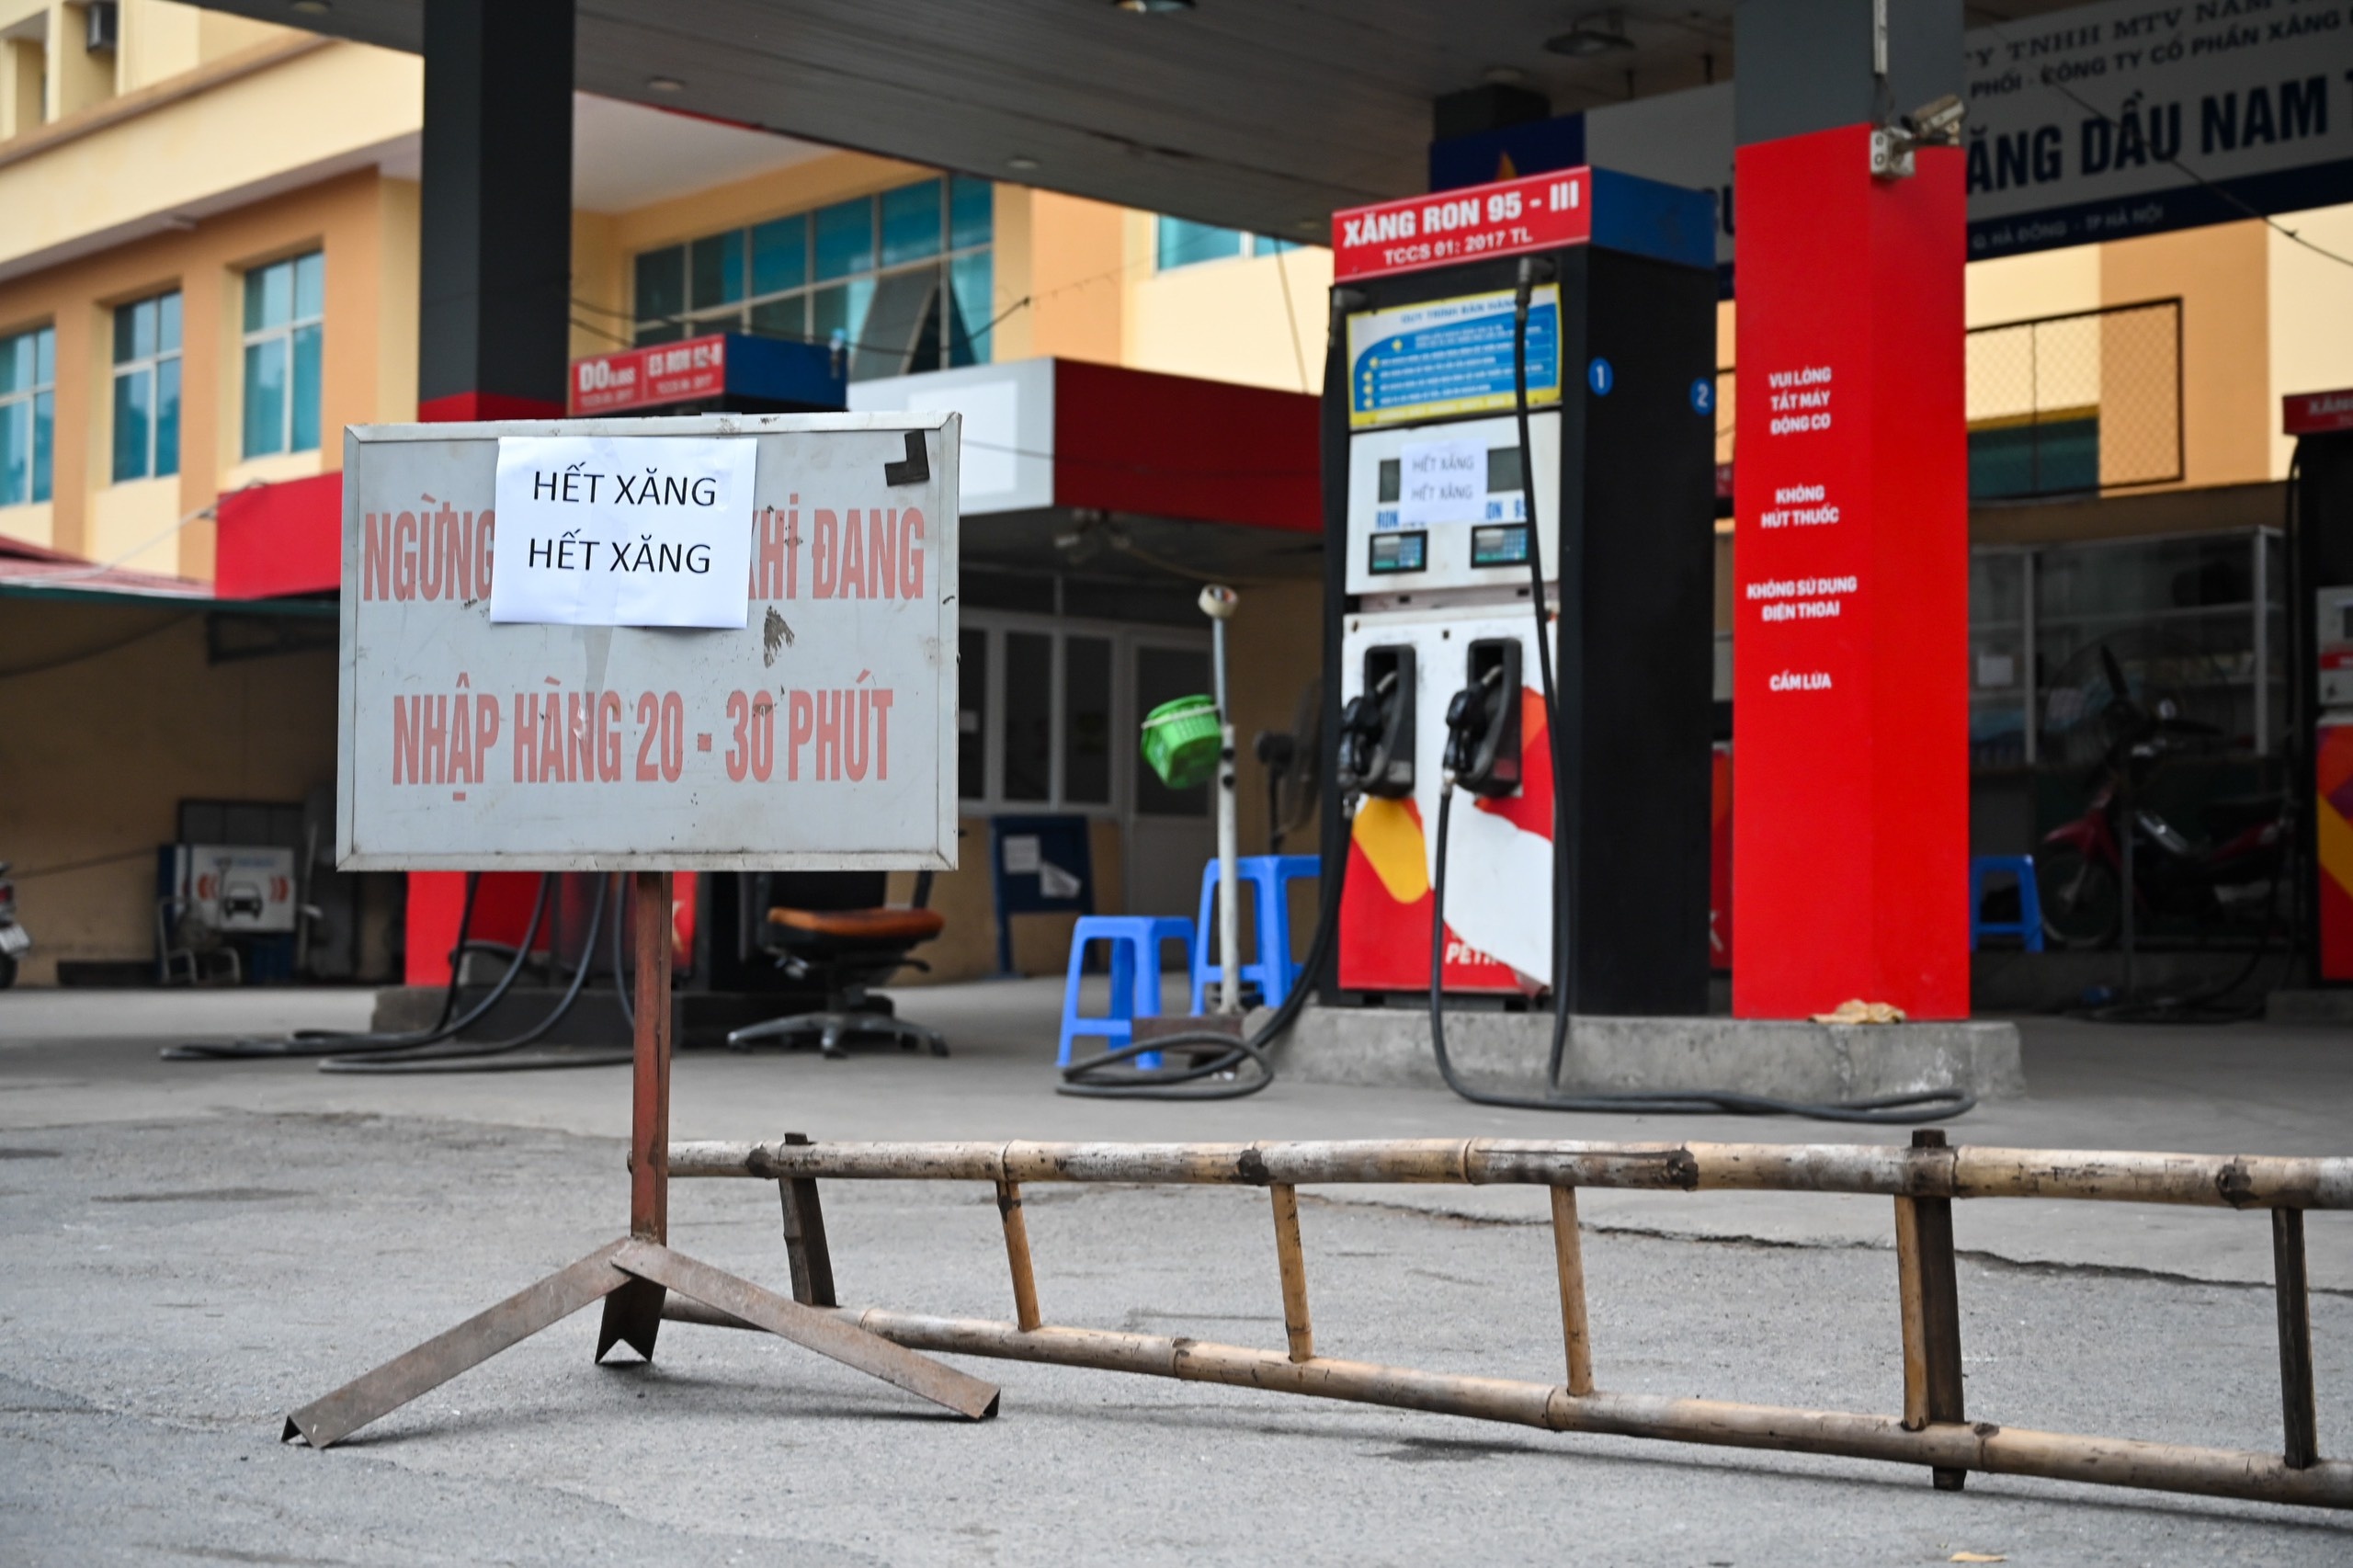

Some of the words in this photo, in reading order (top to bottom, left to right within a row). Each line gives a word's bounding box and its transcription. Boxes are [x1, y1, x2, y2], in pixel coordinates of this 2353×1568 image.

[2006, 24, 2099, 61] TNHH
[2113, 6, 2184, 40] MTV
[2114, 50, 2144, 72] TY
[1967, 125, 2063, 195] ĂNG
[2080, 90, 2180, 176] DẦU
[2200, 74, 2328, 155] NAM
[1343, 210, 1416, 248] XĂNG
[1423, 199, 1480, 233] RON
[1487, 191, 1522, 222] 95
[1550, 180, 1579, 212] III
[1383, 244, 1431, 267] TCCS
[1465, 230, 1506, 252] 2017
[1597, 364, 1605, 390] 1
[1768, 369, 1792, 388] VUI
[1698, 382, 1709, 407] 2
[1412, 454, 1437, 472] HẾT
[1441, 452, 1474, 472] XĂNG
[533, 461, 605, 504] HẾT
[614, 467, 717, 506] XĂNG
[1411, 483, 1436, 501] HẾT
[1440, 483, 1473, 500] XĂNG
[1775, 483, 1825, 505] KHÔNG
[1760, 506, 1790, 528] HÚT
[363, 493, 495, 602] NGỪNG
[812, 507, 925, 600] ĐANG
[529, 528, 600, 571] HẾT
[609, 534, 711, 574] XĂNG
[1746, 578, 1796, 600] KHÔNG
[392, 672, 500, 801] NHẬP
[513, 676, 621, 783] HÀNG
[636, 690, 684, 783] 20
[697, 733, 712, 752] -
[725, 690, 774, 783] 30
[788, 669, 893, 783] PHÚT
